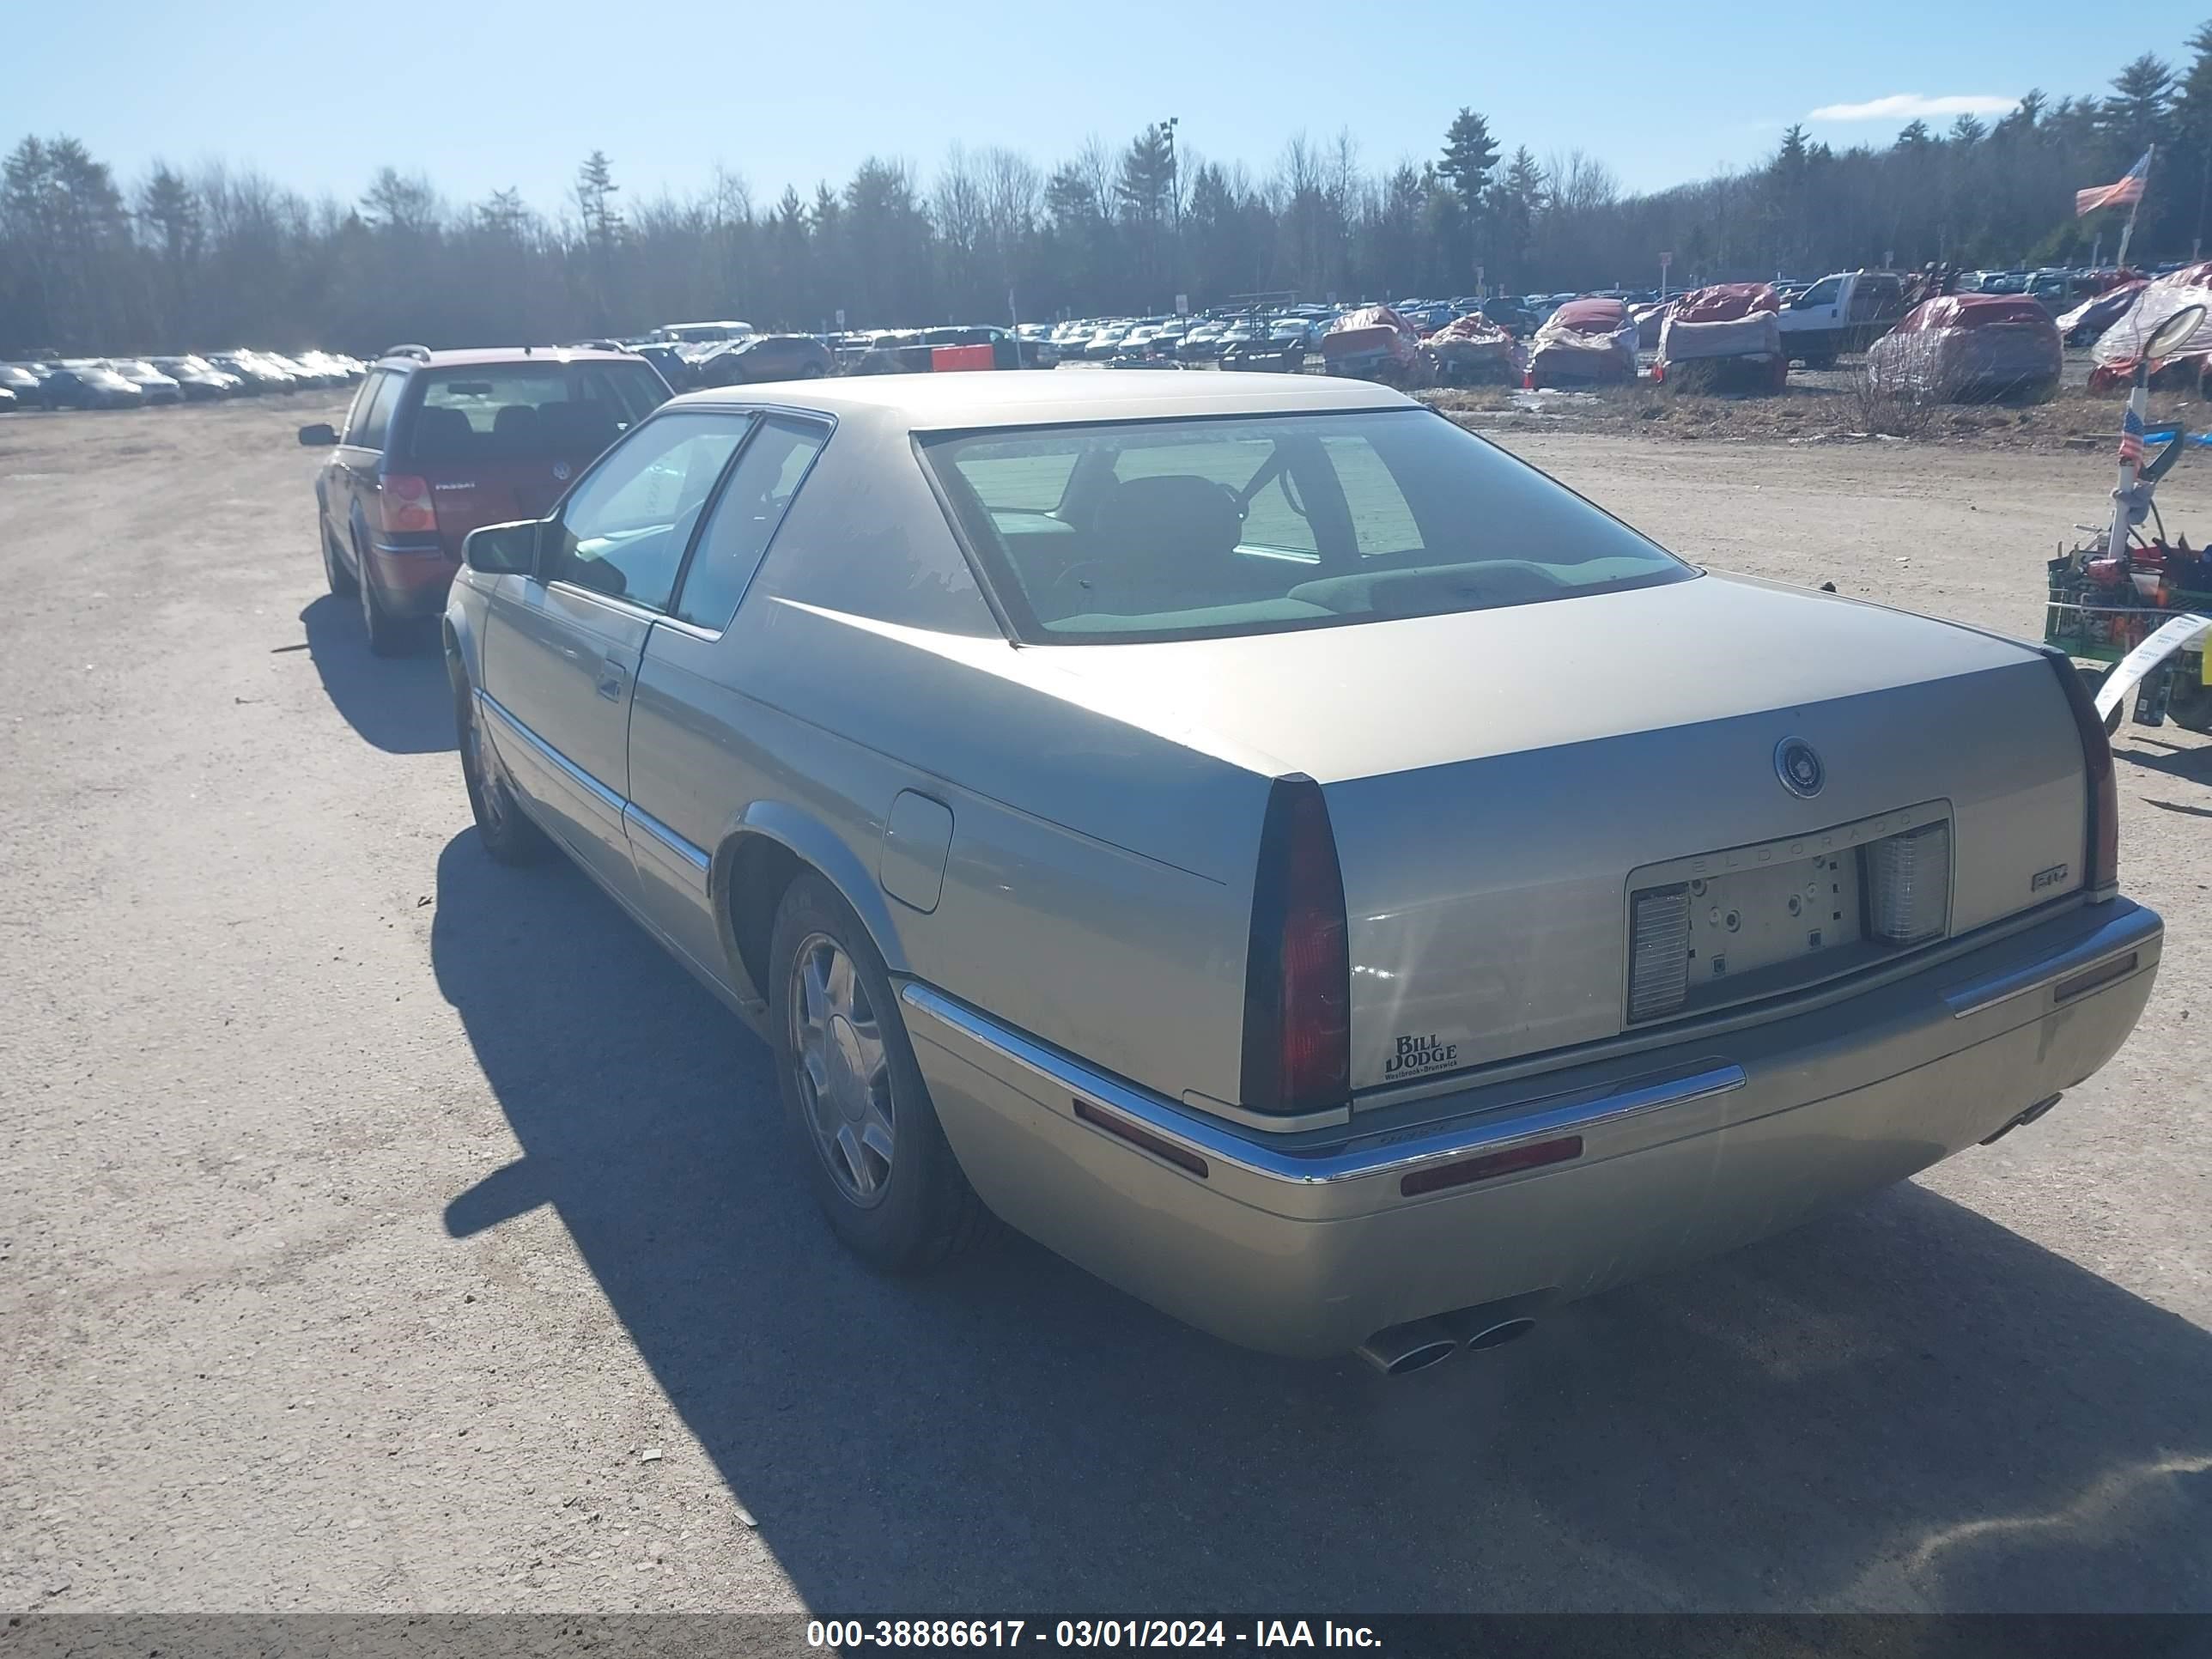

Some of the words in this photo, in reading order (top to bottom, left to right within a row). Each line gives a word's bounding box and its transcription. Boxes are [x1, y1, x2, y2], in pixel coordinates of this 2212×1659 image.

[1692, 813, 1911, 873] ELDORADO
[1384, 1044, 1457, 1073] DODGE
[1395, 1034, 1441, 1055] BILL
